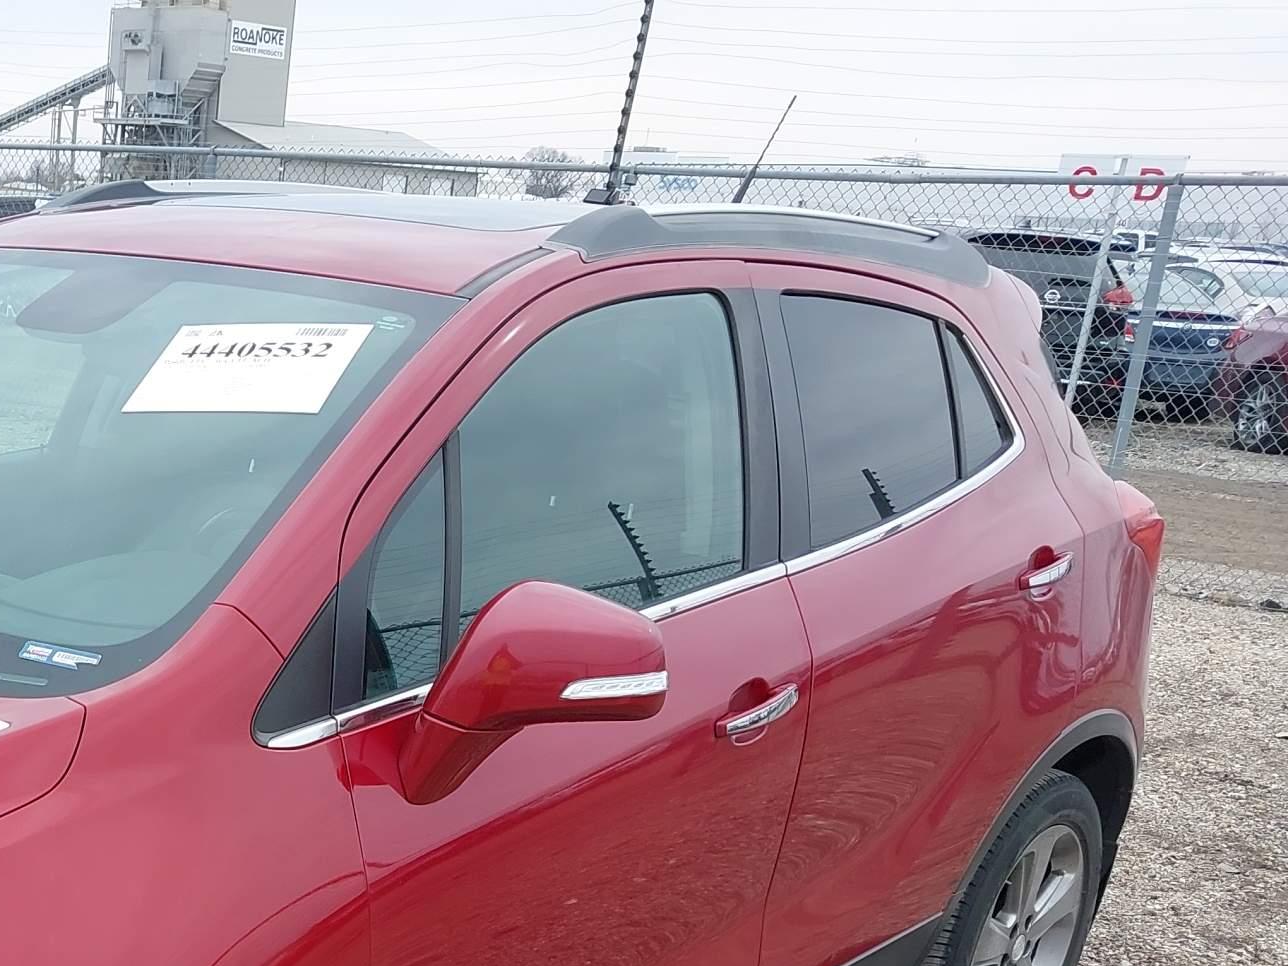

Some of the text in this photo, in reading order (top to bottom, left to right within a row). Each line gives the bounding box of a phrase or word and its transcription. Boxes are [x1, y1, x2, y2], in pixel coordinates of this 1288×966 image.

[232, 27, 285, 46] ROANOKE
[1069, 166, 1165, 200] C D
[181, 342, 334, 359] 44405532
